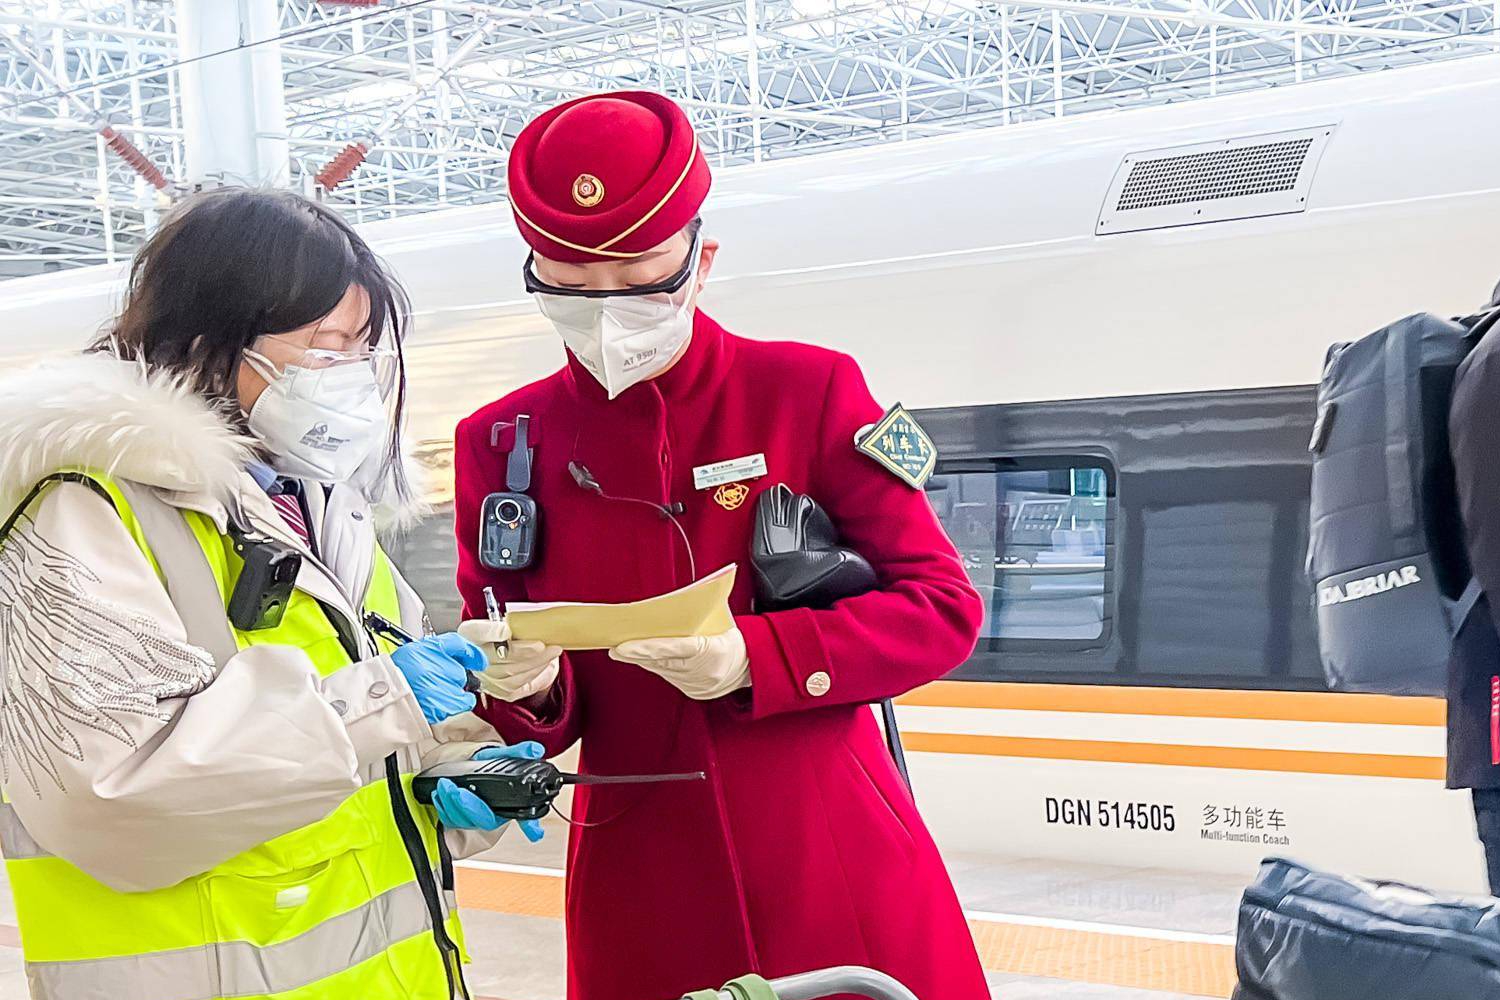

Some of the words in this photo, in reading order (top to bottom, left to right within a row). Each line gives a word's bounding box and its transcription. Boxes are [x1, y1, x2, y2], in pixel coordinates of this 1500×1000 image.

[1045, 797, 1092, 827] DGN
[1097, 800, 1176, 832] 514505
[1202, 804, 1287, 831] 多功能车
[1200, 828, 1261, 844] Multi-function
[1262, 833, 1290, 846] Coach
